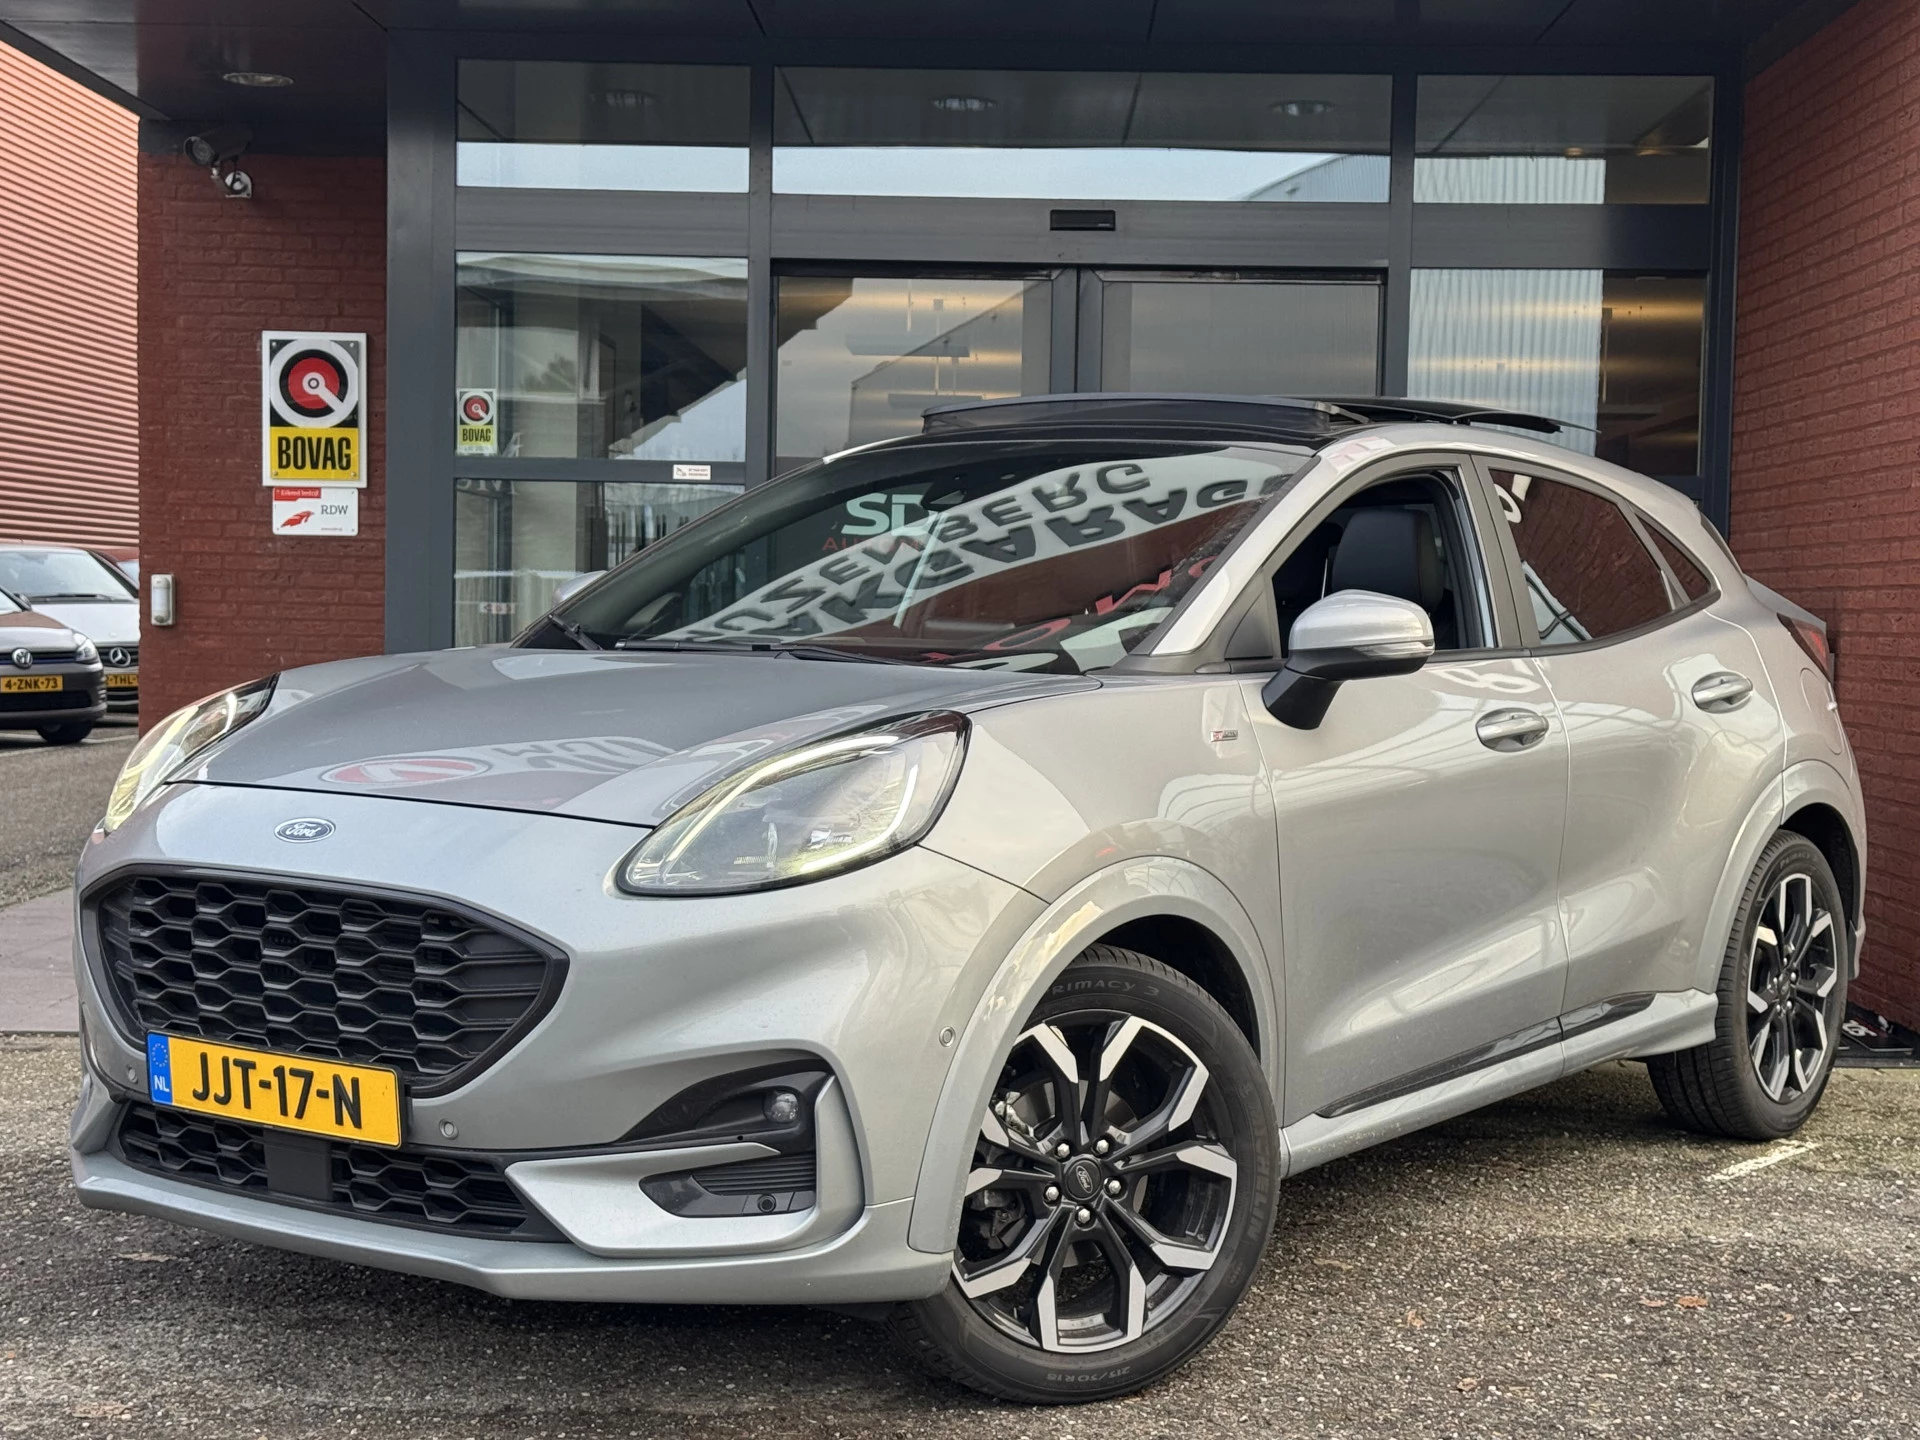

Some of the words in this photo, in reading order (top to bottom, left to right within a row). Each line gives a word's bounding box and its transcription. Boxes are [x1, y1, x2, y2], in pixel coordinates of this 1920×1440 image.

[462, 428, 491, 442] BOVAG
[277, 436, 352, 471] BOVAG
[321, 504, 349, 515] RDW
[5, 678, 58, 690] 4-ZNK-73
[285, 822, 321, 837] Ford
[1051, 979, 1136, 995] RIMACY
[154, 1075, 170, 1092] NL
[192, 1052, 362, 1129] JJT-17-N
